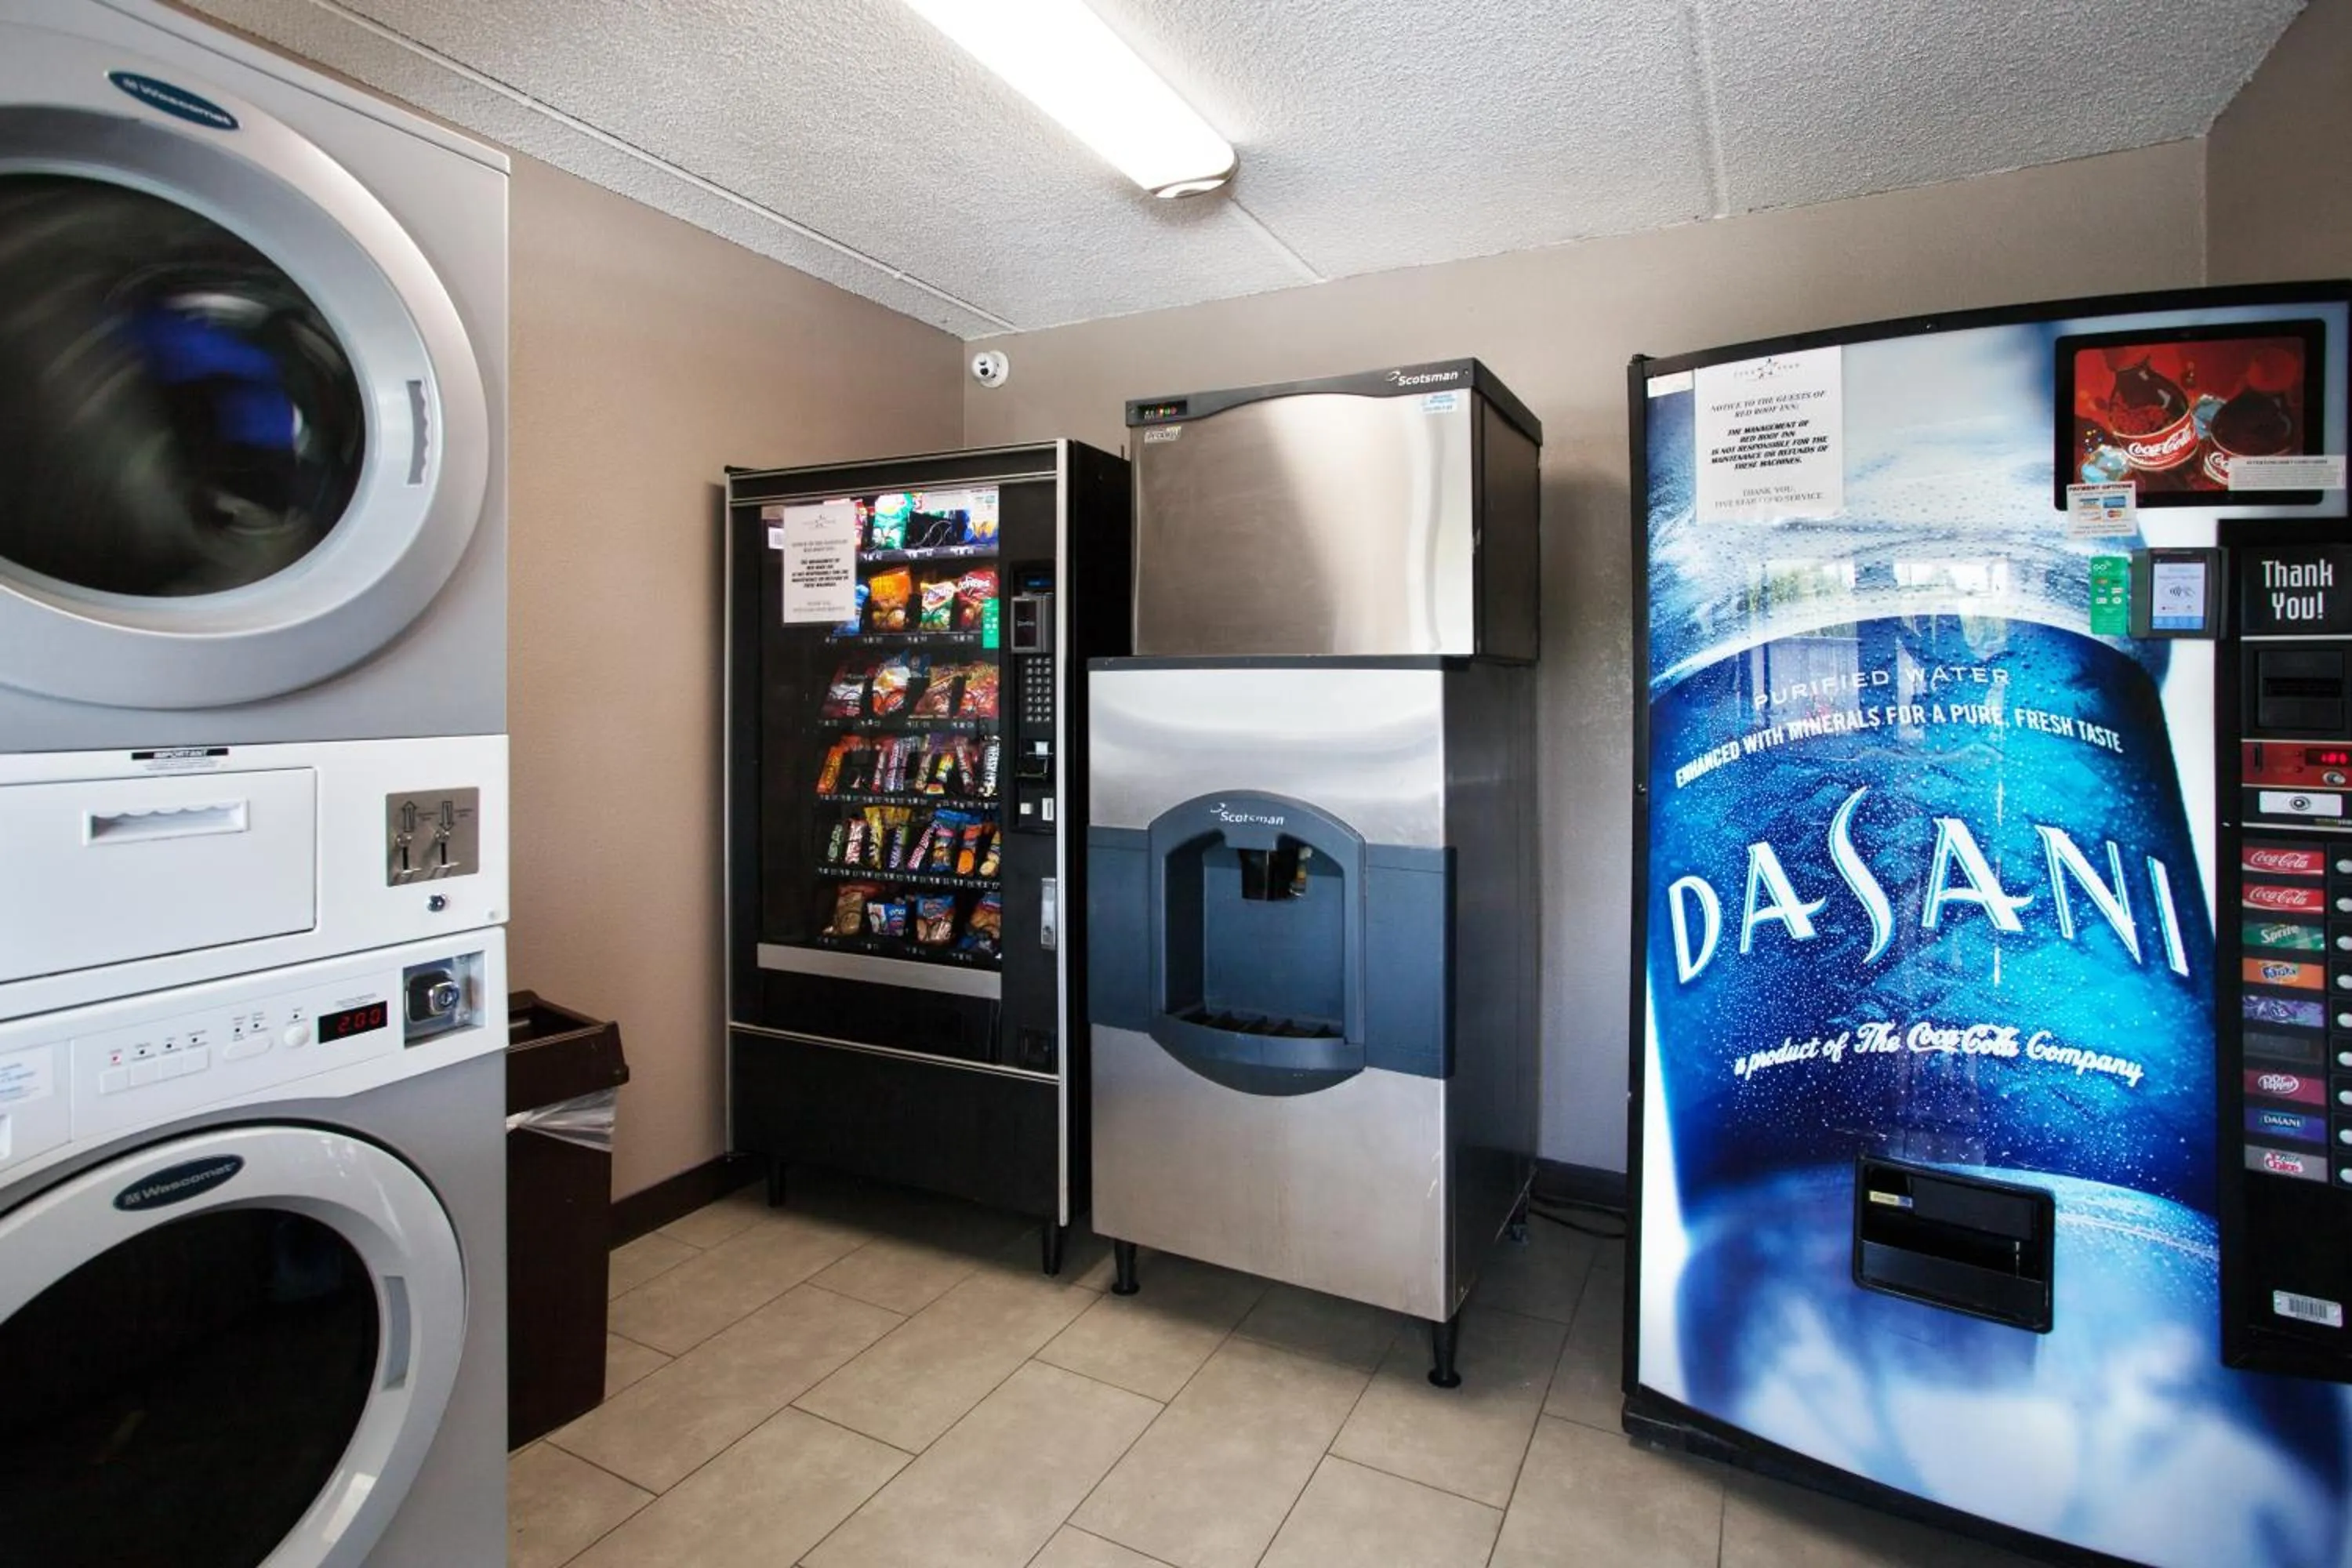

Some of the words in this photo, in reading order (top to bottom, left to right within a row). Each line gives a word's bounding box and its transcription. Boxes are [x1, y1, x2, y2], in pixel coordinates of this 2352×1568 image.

[1398, 371, 1458, 386] Scotsman
[1757, 397, 1774, 406] THE
[1734, 408, 1752, 418] RED
[1754, 406, 1777, 416] ROOF
[1744, 420, 1796, 434] MANAGEMENT
[1758, 432, 1779, 441] ROOF
[1711, 448, 1719, 456] IS
[1721, 445, 1735, 455] NOT
[1737, 439, 1790, 452] RESPONSIBLE
[1791, 437, 1810, 446] FOR
[1812, 435, 1828, 444] THE
[1711, 451, 1762, 464] MAINTENANCE
[1763, 449, 1777, 458] OR
[1777, 446, 1816, 457] REFUNDS
[1817, 444, 1829, 452] OF
[1733, 461, 1758, 470] THESE
[2261, 558, 2334, 588] Thank
[2271, 591, 2324, 620] You!
[1755, 670, 1889, 710] PURIFIED
[1906, 666, 2010, 685] WATER
[1675, 741, 1741, 789] ENHANCED
[1742, 725, 1784, 754] WITH
[1788, 708, 1882, 742] MINERALS
[1886, 705, 1926, 725] FOR
[1932, 704, 1947, 724] A
[2013, 708, 2074, 738] FRESH
[2077, 721, 2125, 753] TASTE
[1219, 811, 1285, 826] Scotsman
[1668, 785, 2190, 985] DASANI
[2260, 924, 2300, 944] Sprite
[1733, 1056, 1746, 1076] a
[1744, 1036, 1820, 1081] product
[1821, 1030, 1850, 1062] of
[1853, 1022, 1902, 1054] The
[1906, 1022, 2021, 1058] Coca-Cola
[2025, 1029, 2144, 1088] Company
[2263, 1114, 2302, 1127] DASANI
